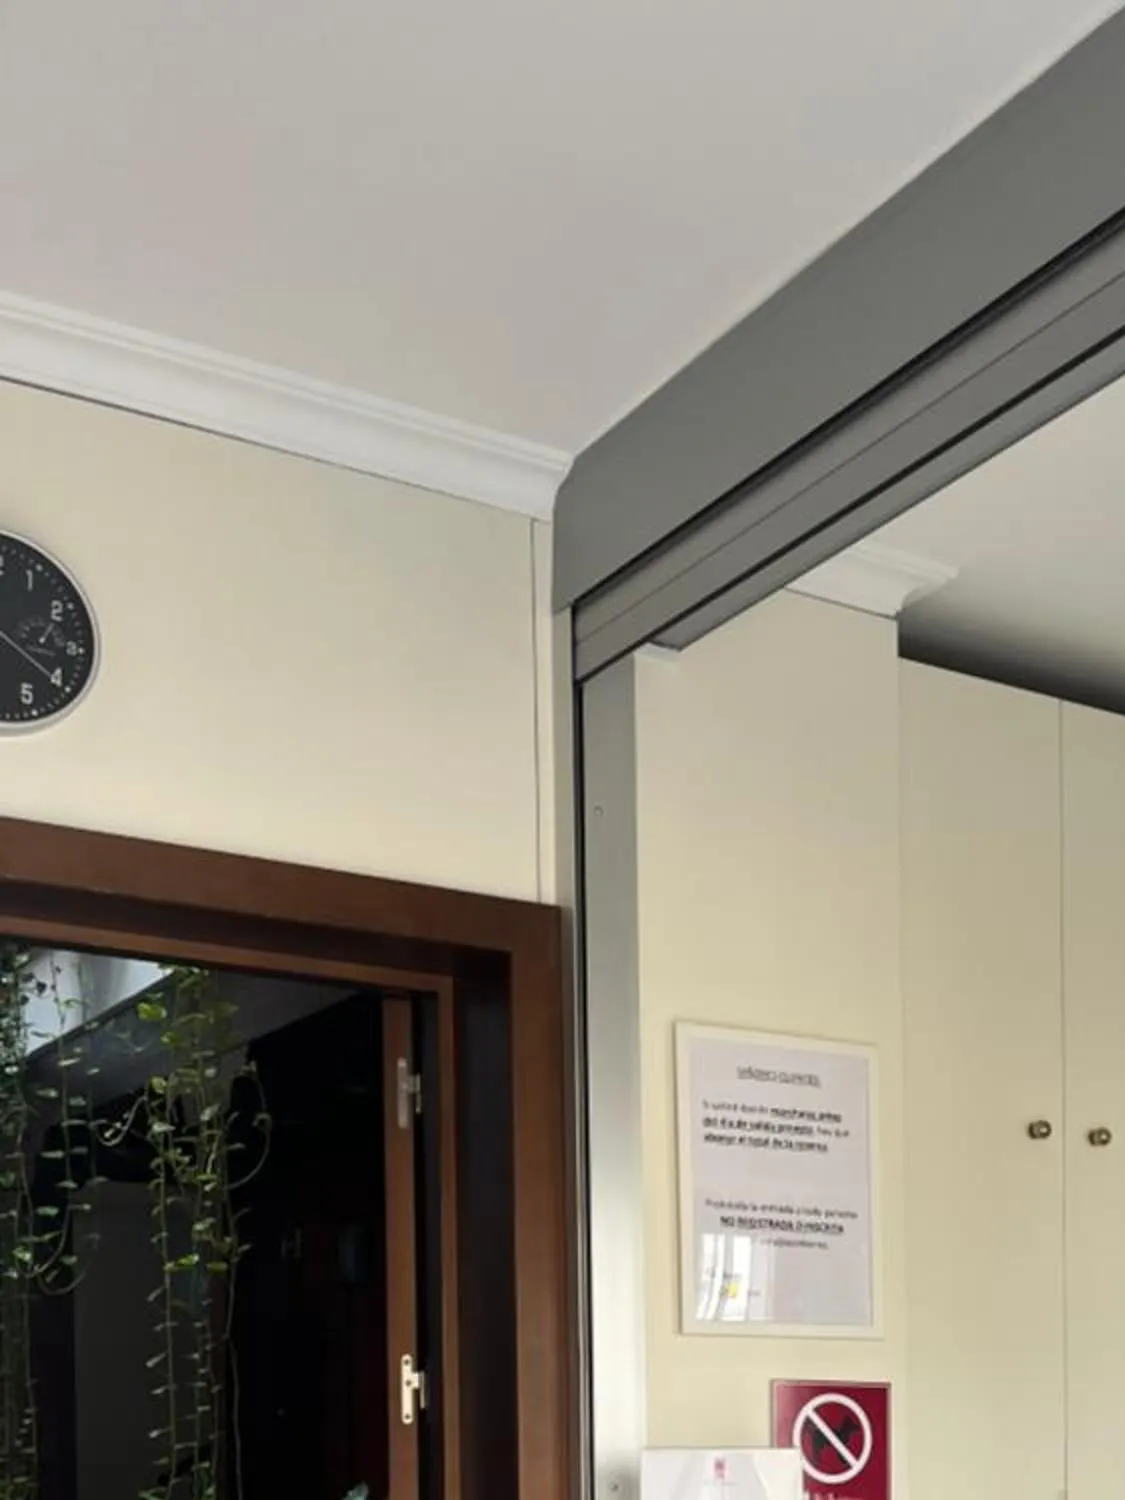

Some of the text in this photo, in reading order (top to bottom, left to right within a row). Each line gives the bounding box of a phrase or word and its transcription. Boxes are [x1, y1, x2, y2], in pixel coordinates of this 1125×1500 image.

[51, 600, 63, 622] 2
[51, 667, 63, 687] 4
[20, 682, 33, 704] 5
